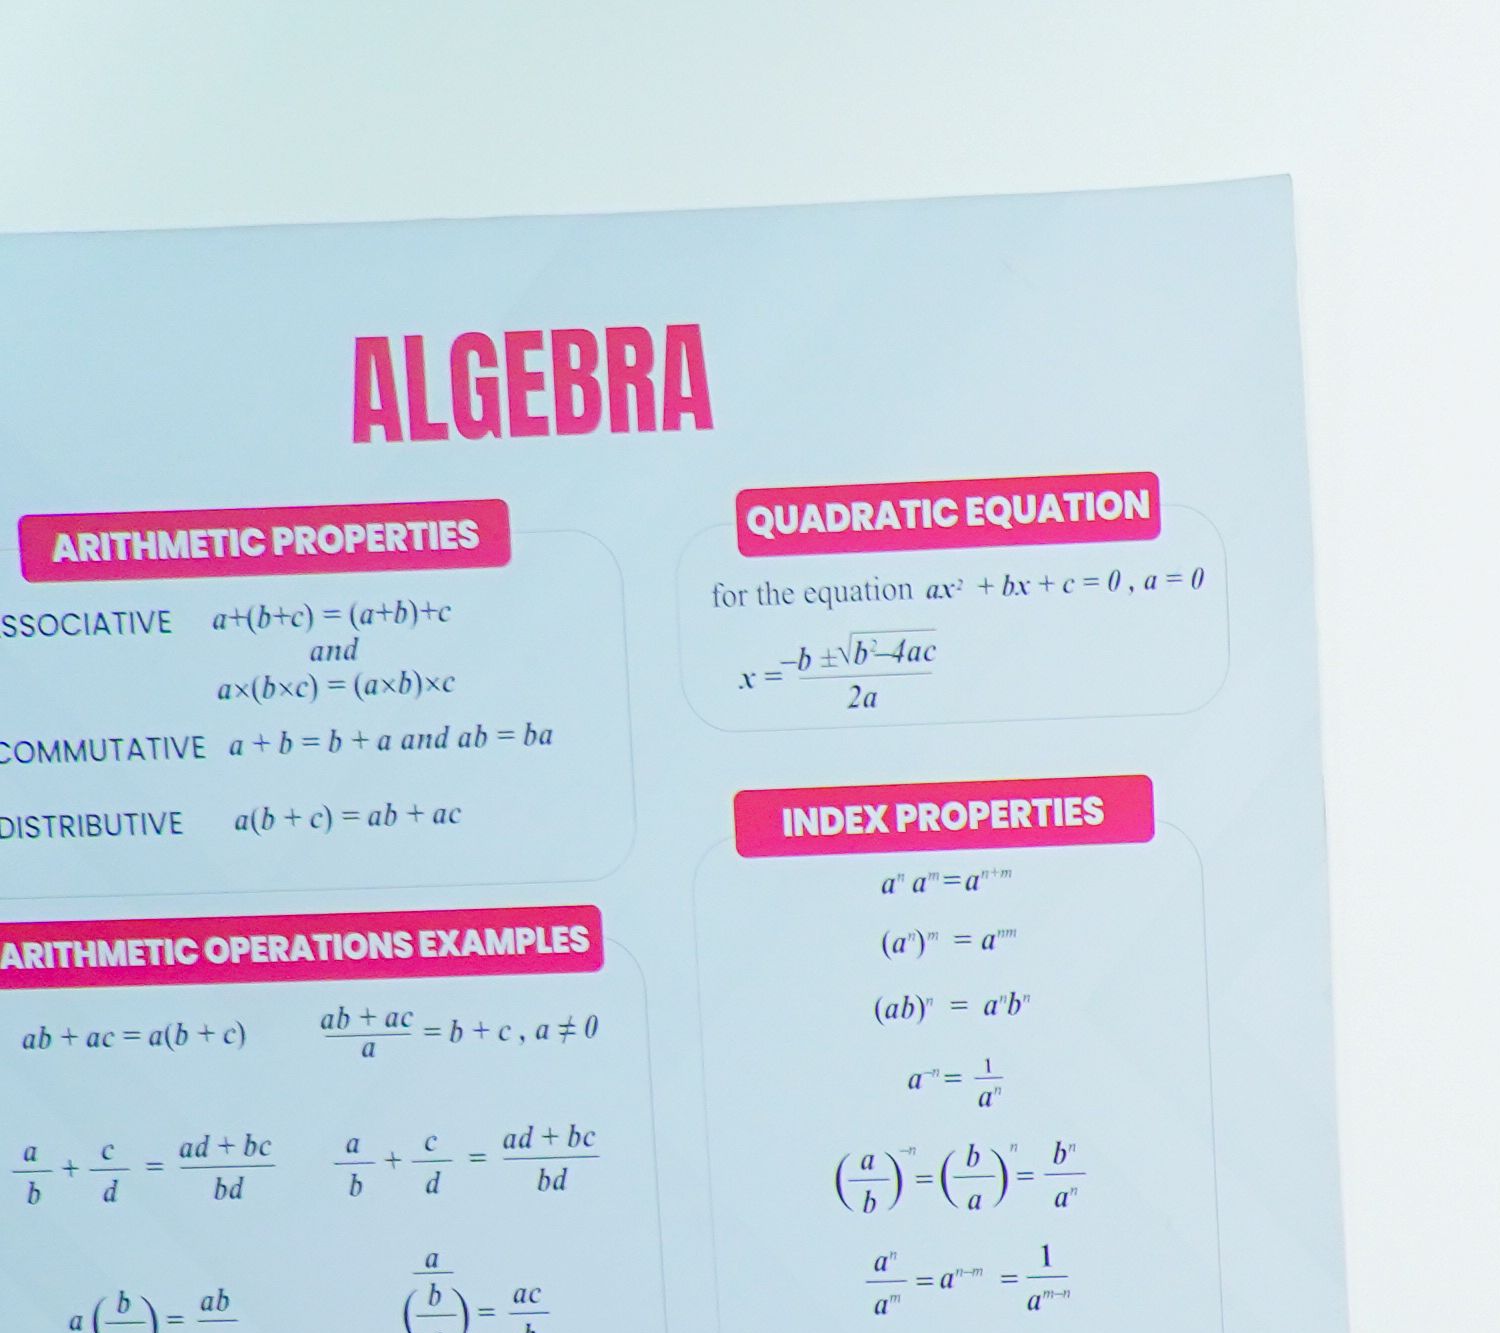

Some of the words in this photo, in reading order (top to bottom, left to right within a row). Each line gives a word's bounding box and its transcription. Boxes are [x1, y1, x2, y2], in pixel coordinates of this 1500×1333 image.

[352, 324, 714, 443] ALGEBRA
[746, 497, 959, 540] QUADRATIC
[965, 488, 1150, 530] EQUATION
[51, 526, 266, 563] ARITHMETIC
[271, 518, 480, 556] PROPERTIES
[711, 581, 749, 609] for
[755, 580, 795, 607] the
[803, 575, 914, 611] equation
[1001, 573, 1032, 598] bx
[1190, 566, 1205, 591] 0
[0, 609, 173, 639] SSOCIATIVE
[211, 602, 315, 636] a+(b+c)
[348, 598, 452, 632] (a+b)+c
[309, 636, 360, 663] and
[846, 684, 879, 710] 2a
[400, 724, 451, 751] and
[456, 723, 489, 749] ab
[522, 721, 554, 747] ba
[367, 801, 399, 828] ab
[431, 806, 462, 825] ac
[782, 804, 890, 837] INDEX
[895, 795, 1105, 833] PROPERTIES
[0, 937, 199, 970] ARITHMETIC
[203, 930, 414, 964] OPERATIONS
[418, 924, 590, 958] EXAMPLES
[21, 1025, 53, 1051] ab
[85, 1030, 116, 1049] ac
